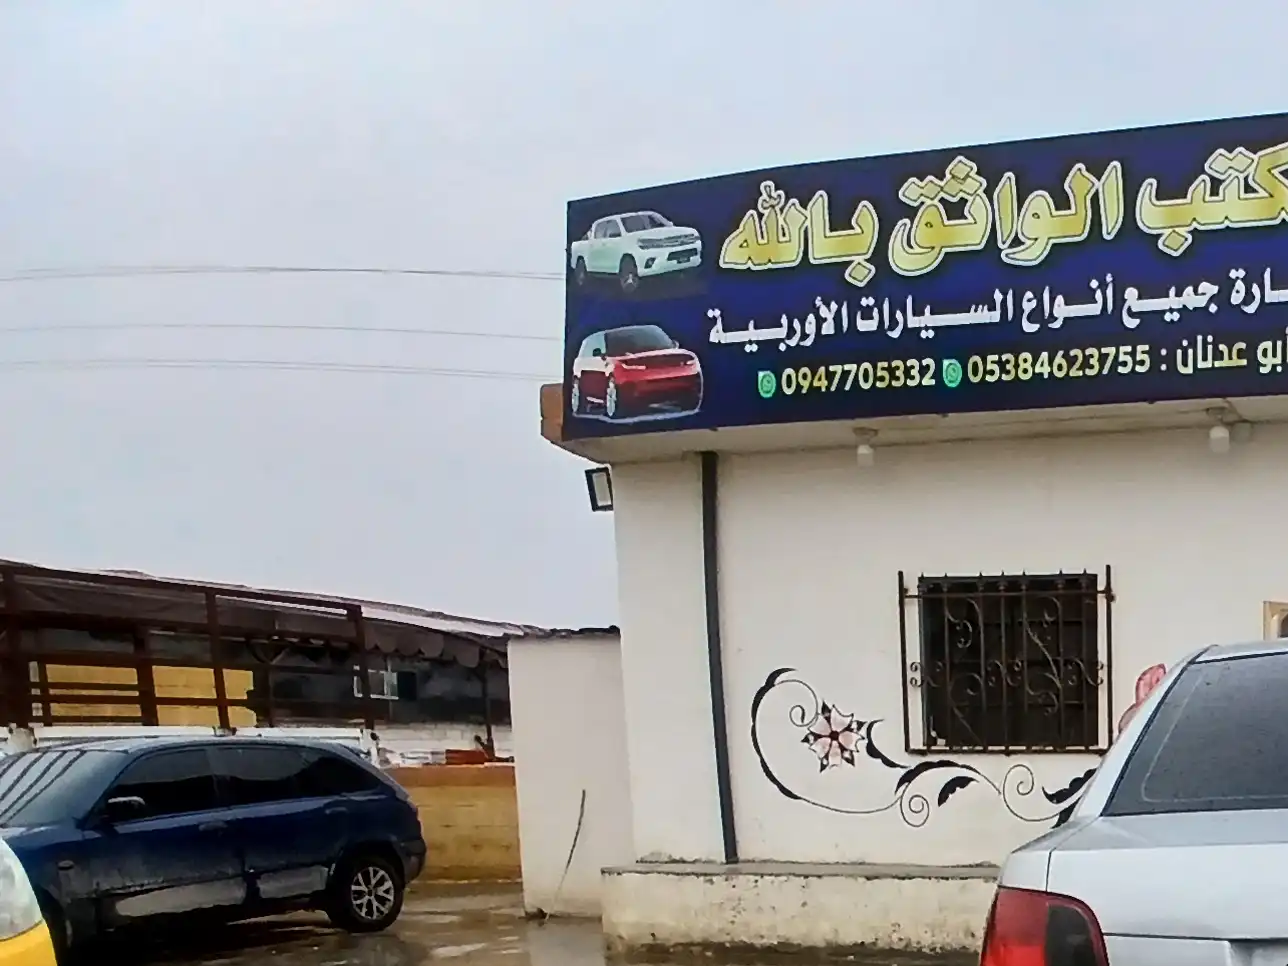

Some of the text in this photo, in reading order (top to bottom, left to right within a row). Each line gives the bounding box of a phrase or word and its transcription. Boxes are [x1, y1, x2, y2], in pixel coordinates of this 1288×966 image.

[719, 180, 879, 286] بالله
[888, 156, 1124, 277] الواثق
[707, 296, 848, 352] الأوربية
[856, 288, 1013, 339] السيارات
[1022, 273, 1113, 333] أنواع
[1122, 280, 1219, 329] جميع
[781, 358, 936, 395] 0947705332
[967, 345, 1150, 383] 05384623755
[1176, 334, 1247, 374] عدنان
